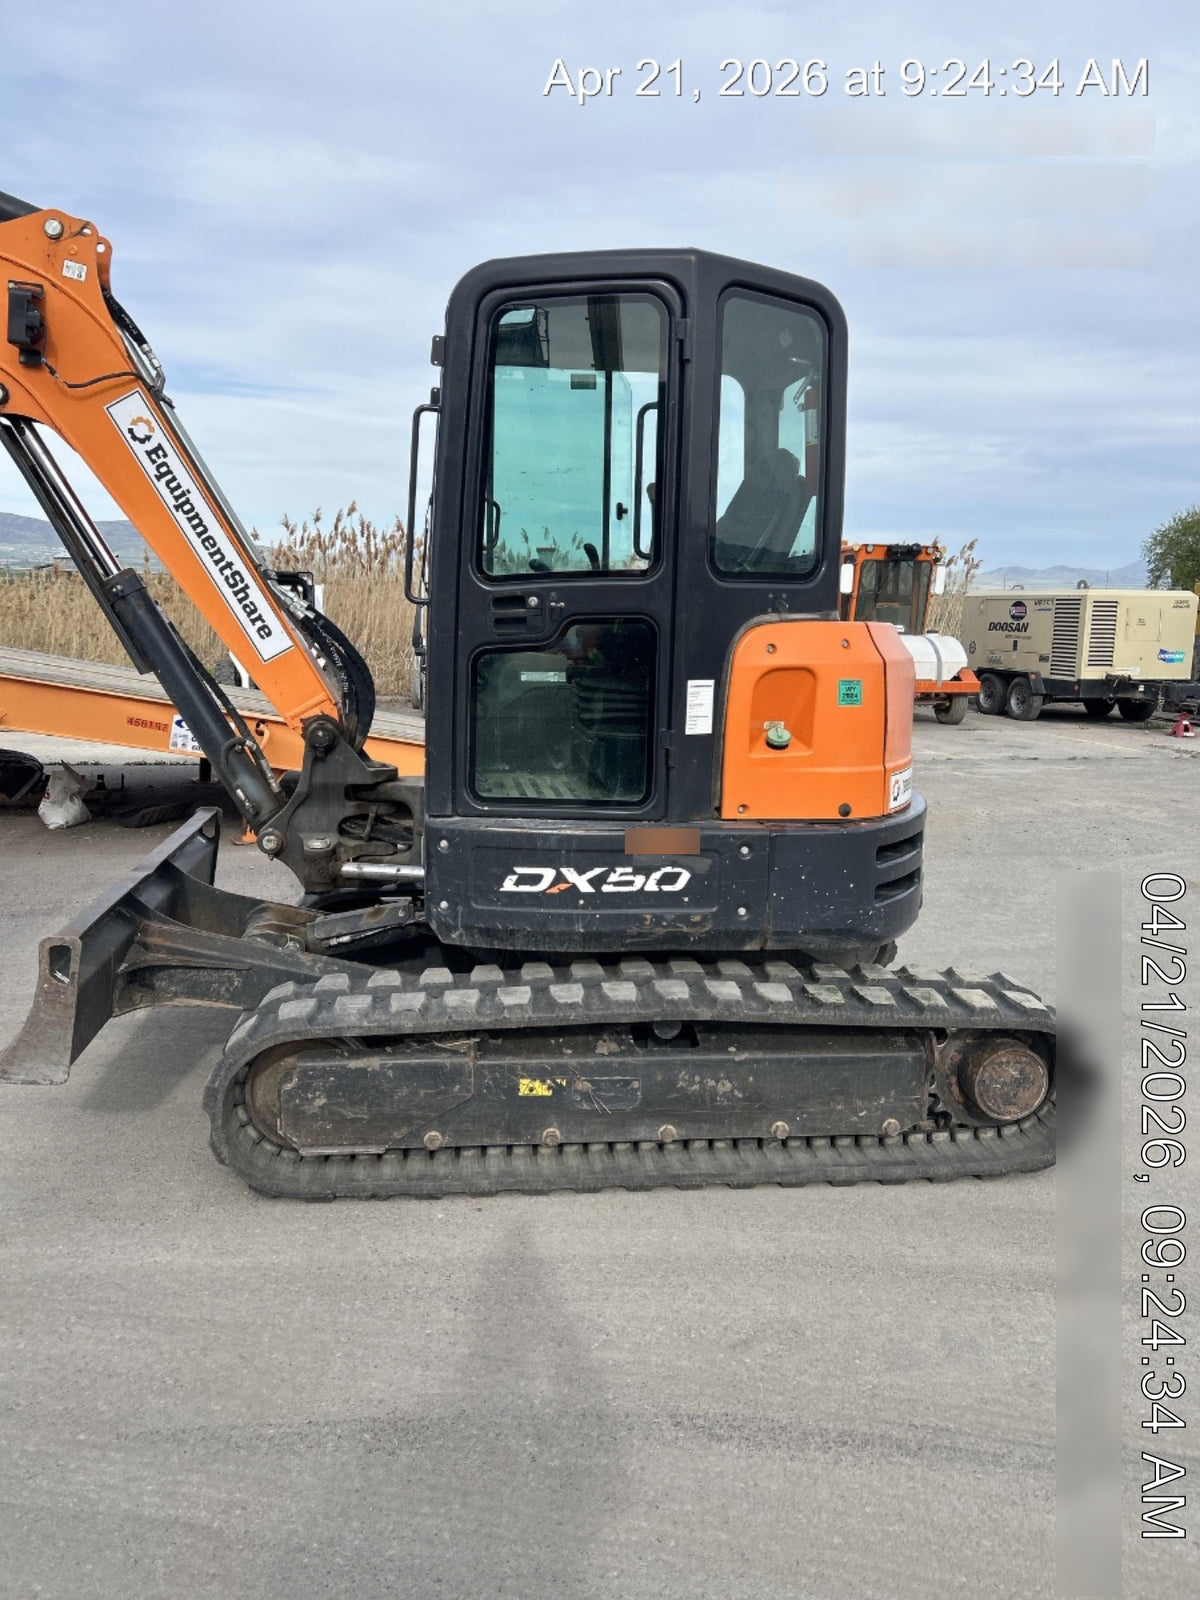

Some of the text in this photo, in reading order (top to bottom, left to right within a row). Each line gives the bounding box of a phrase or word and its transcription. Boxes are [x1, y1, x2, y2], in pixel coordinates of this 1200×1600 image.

[145, 442, 274, 641] EquipmentShare
[988, 622, 1029, 633] DOOSAN
[498, 866, 693, 894] DX50
